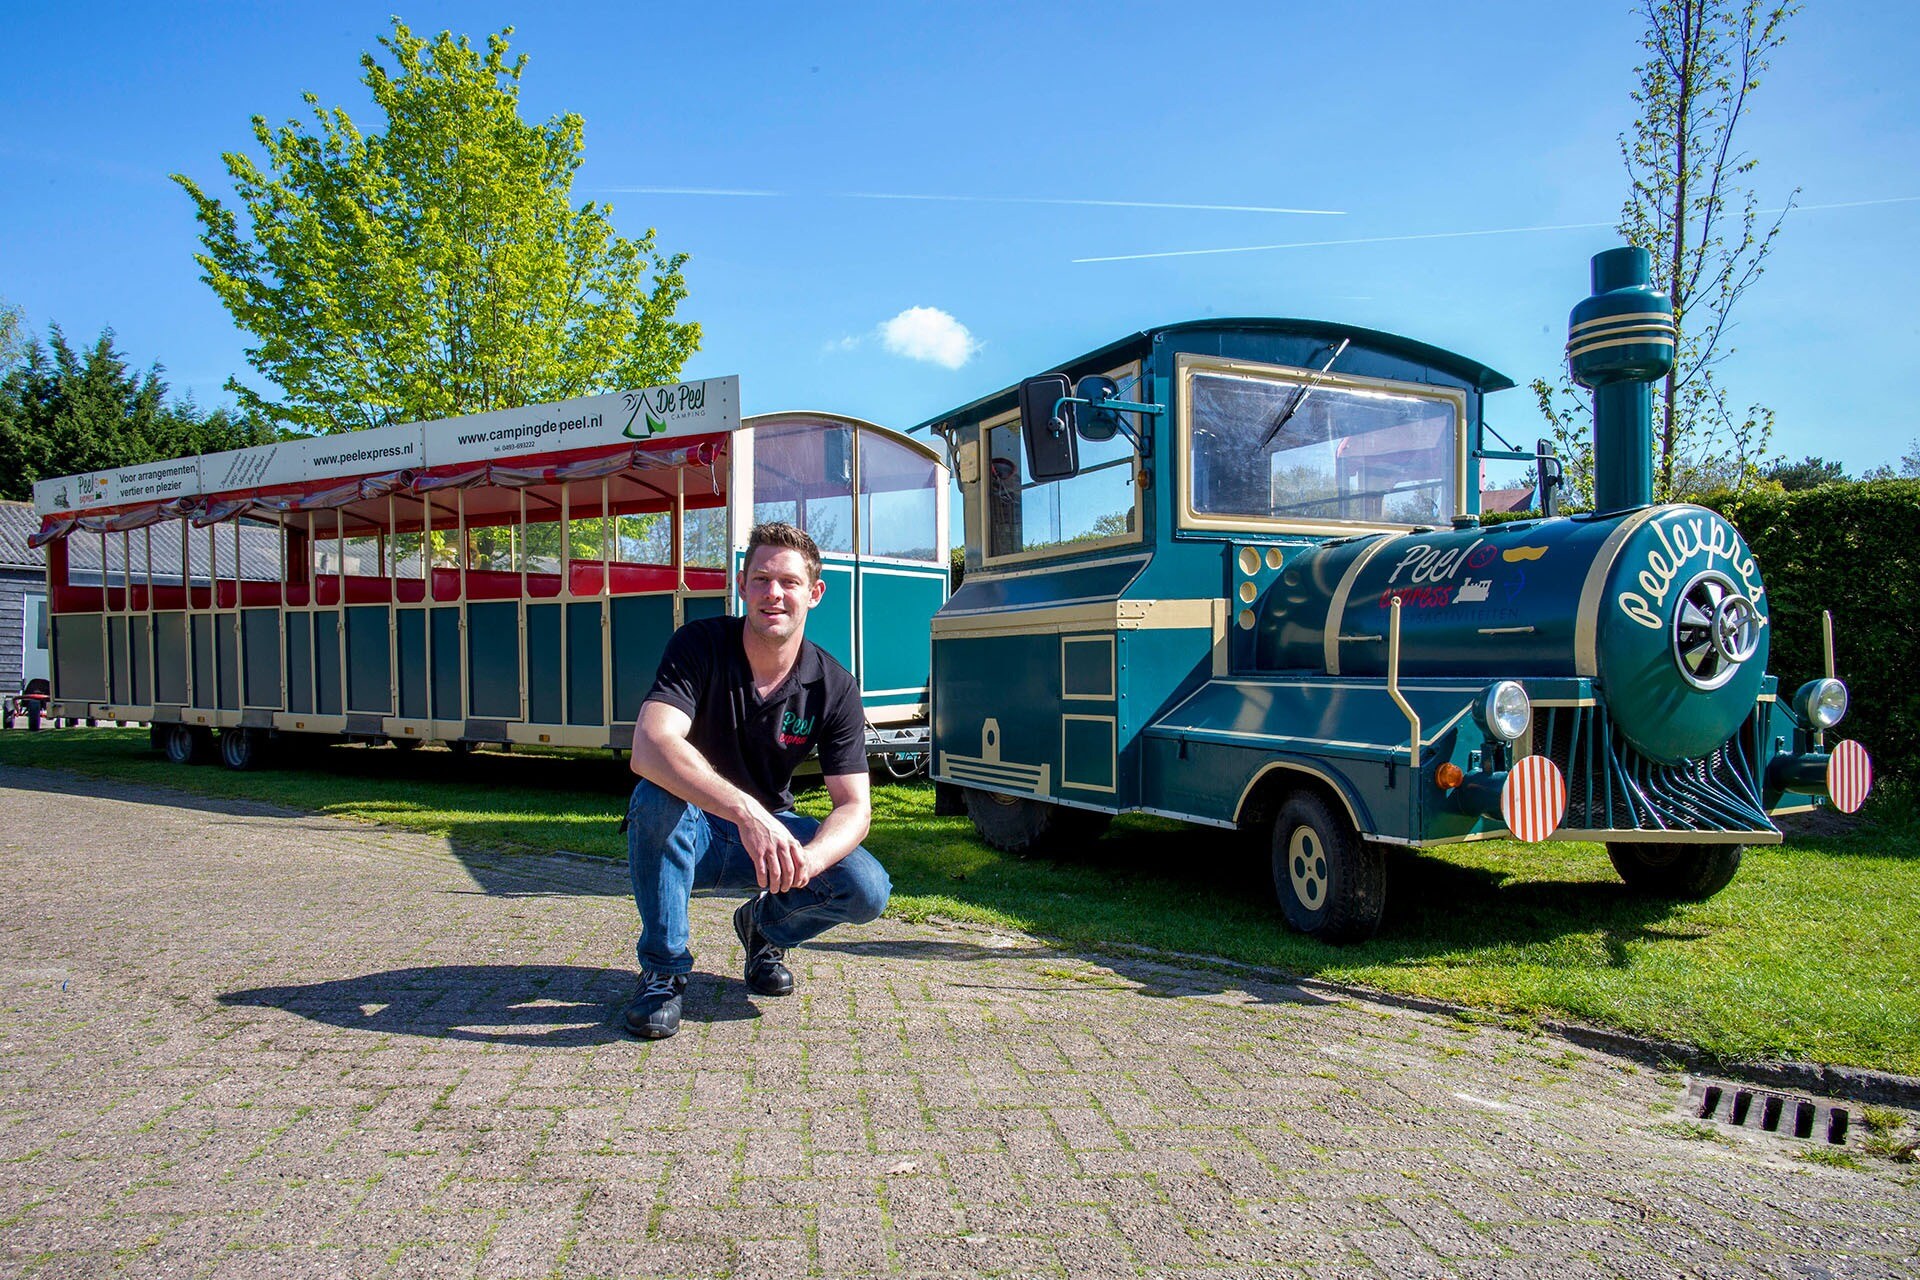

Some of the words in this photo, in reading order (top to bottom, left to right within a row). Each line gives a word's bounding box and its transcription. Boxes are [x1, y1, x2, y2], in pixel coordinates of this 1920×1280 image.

[655, 388, 677, 414] De
[677, 381, 706, 411] Peel
[670, 409, 706, 420] CAMPING
[457, 414, 603, 445] www.campingdepeel.nl
[312, 442, 414, 466] www.peelexpress.nl
[78, 473, 95, 495] Peel
[119, 473, 137, 483] Voor
[120, 486, 144, 498] vertier
[145, 484, 155, 494] en
[155, 480, 183, 494] plezier
[1388, 538, 1485, 584] Peel
[1378, 586, 1454, 609] express
[781, 711, 816, 735] Peel
